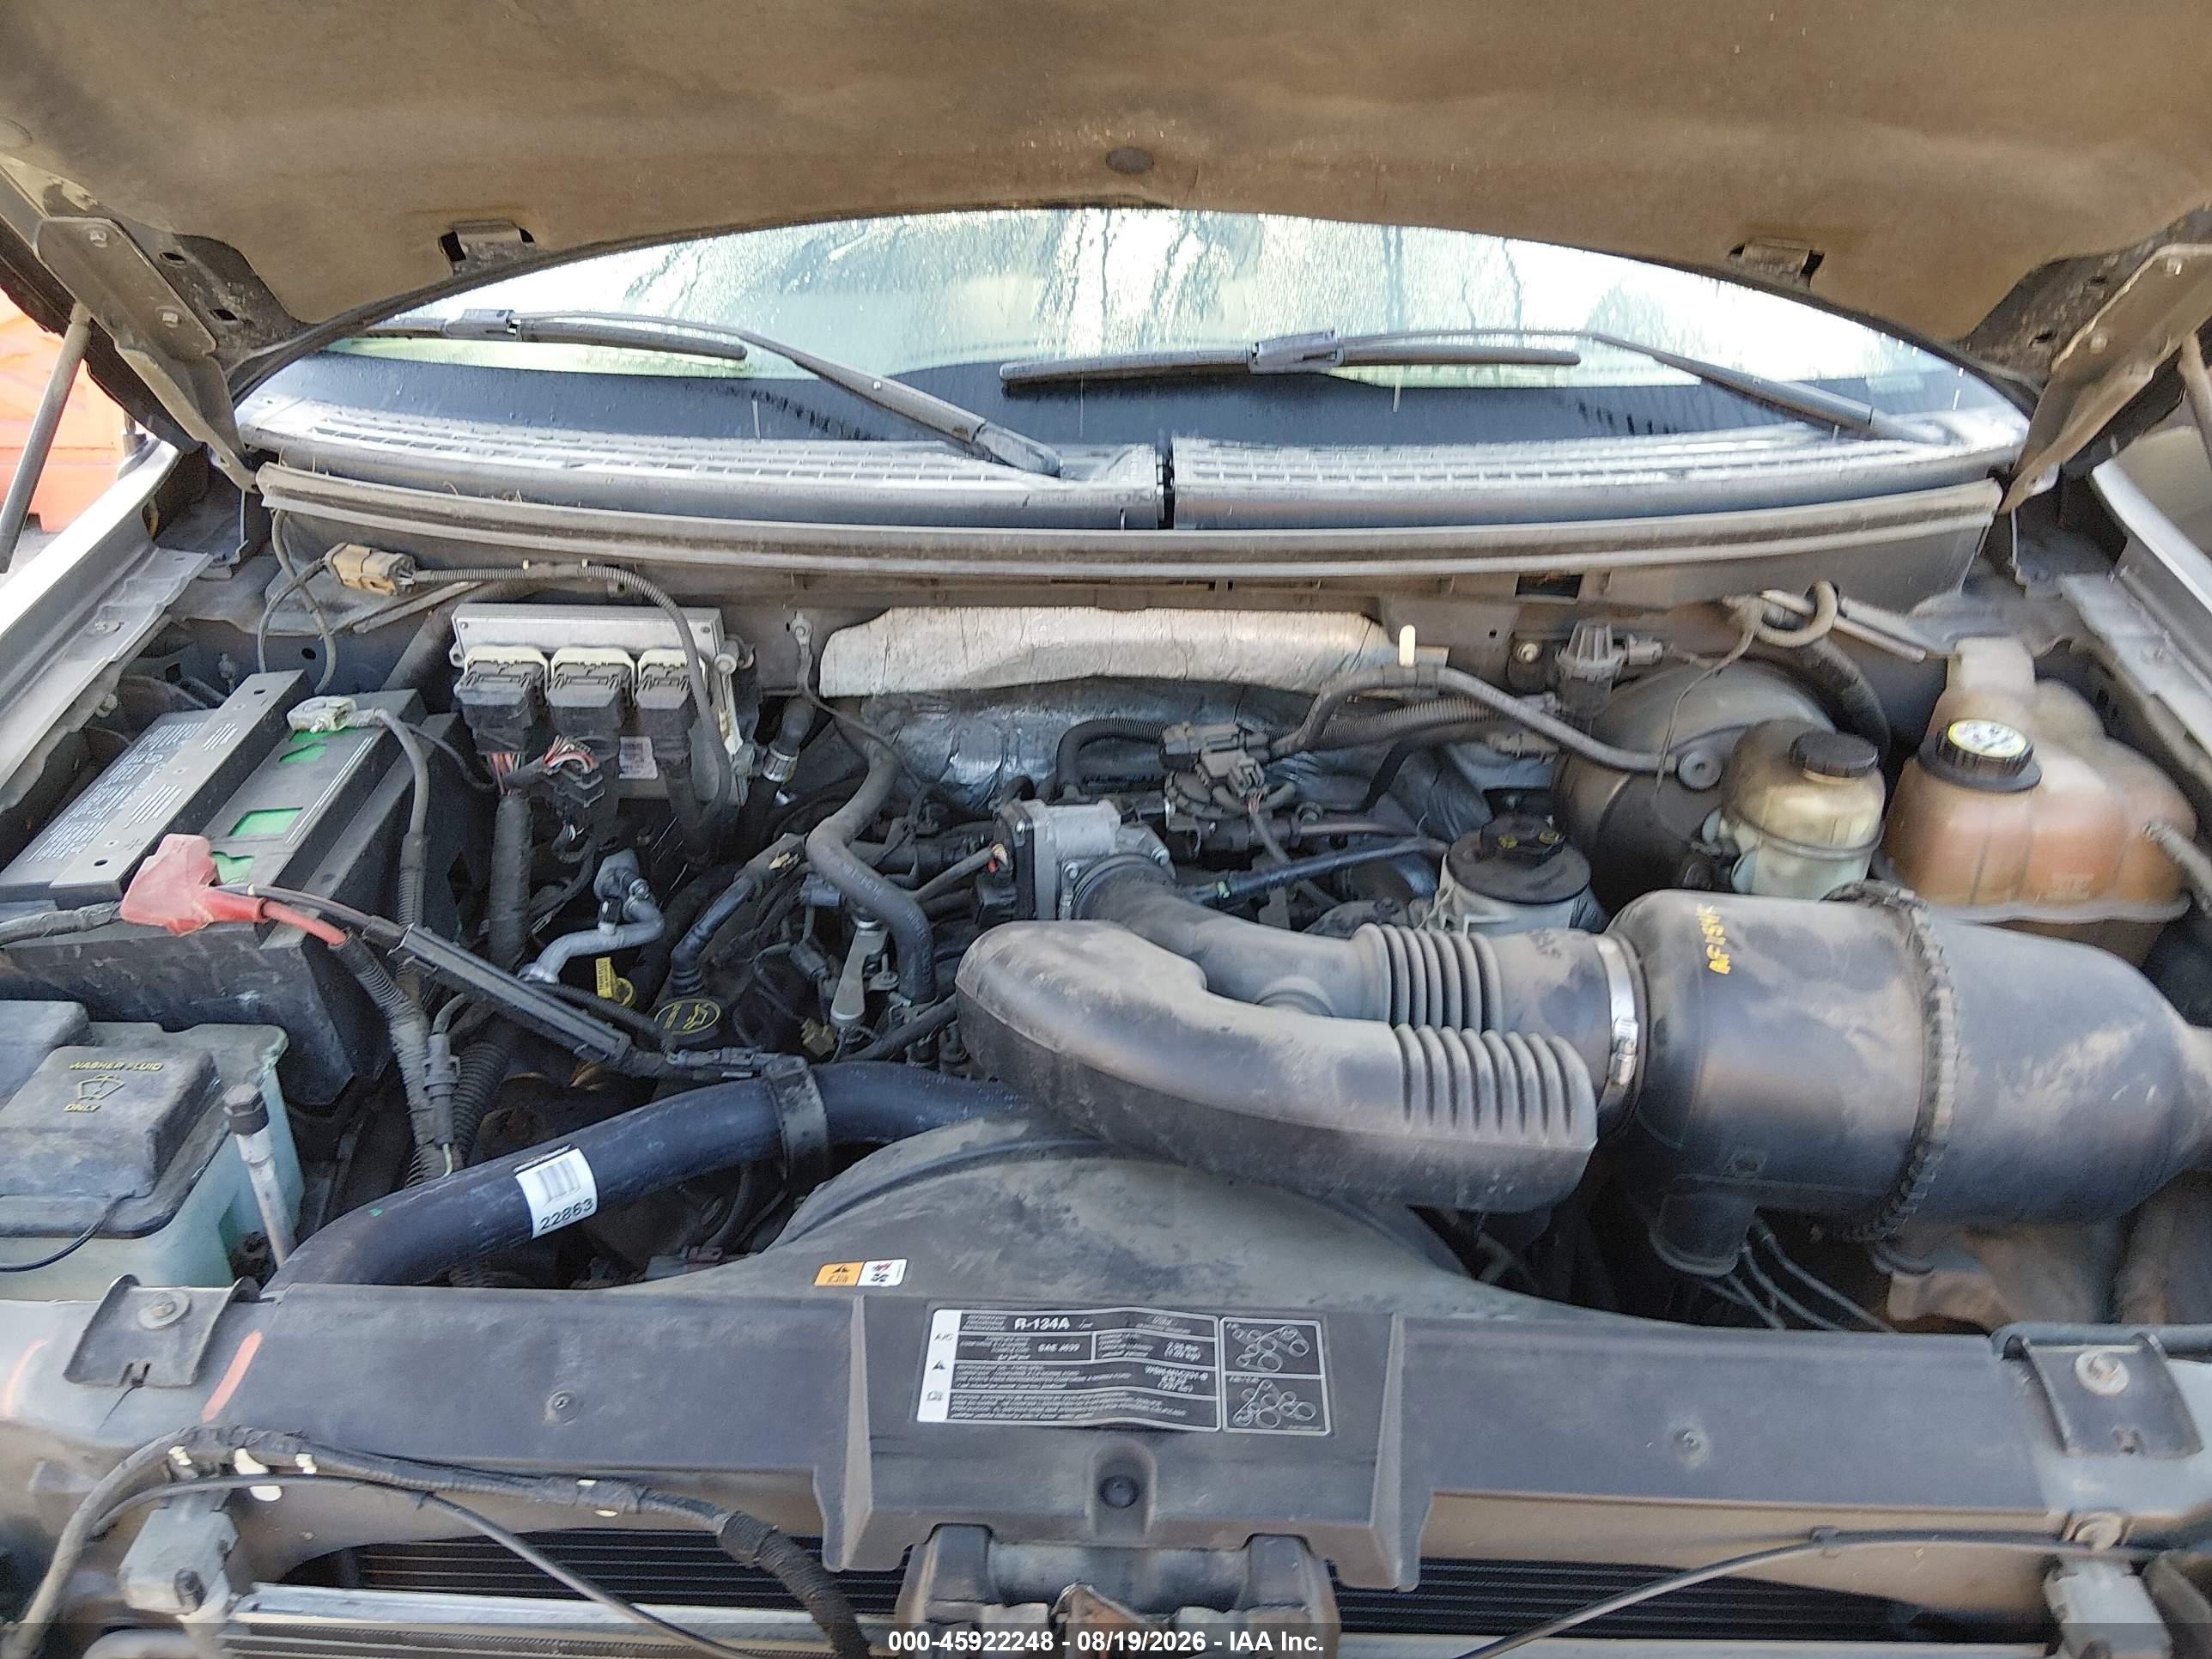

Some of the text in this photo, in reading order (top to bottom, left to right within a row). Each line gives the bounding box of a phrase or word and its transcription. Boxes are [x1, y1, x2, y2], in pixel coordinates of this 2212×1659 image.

[69, 1061, 125, 1071] WASHER
[64, 1103, 101, 1113] ONLY
[539, 1198, 594, 1231] 22863
[1014, 1317, 1070, 1330] R-134A
